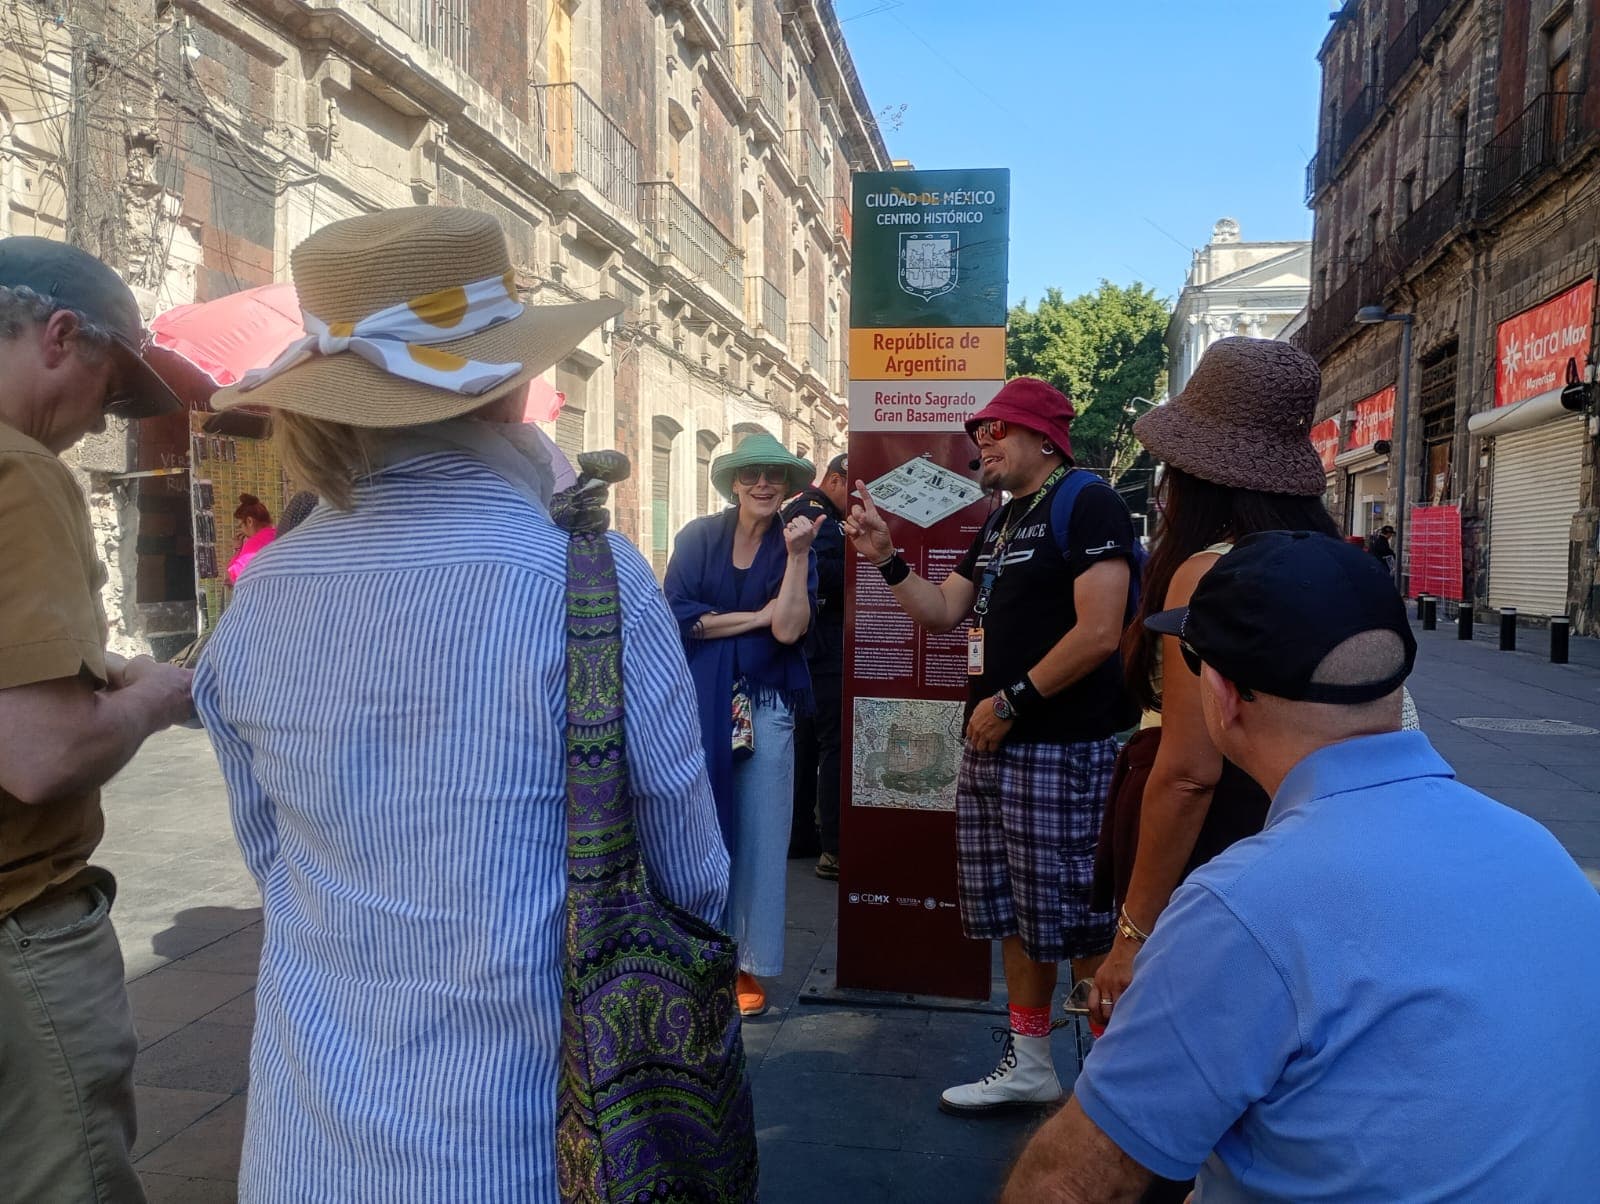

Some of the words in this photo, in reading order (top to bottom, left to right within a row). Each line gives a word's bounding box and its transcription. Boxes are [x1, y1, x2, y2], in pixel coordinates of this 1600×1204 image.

[865, 192, 917, 208] CIUDAD
[921, 191, 940, 207] DE
[943, 188, 996, 206] MÉXICO
[876, 212, 921, 226] CENTRO
[924, 209, 983, 225] HISTÓRICO
[873, 332, 955, 354] República
[960, 332, 980, 350] de
[1523, 330, 1560, 365] tiara
[1561, 324, 1588, 349] Max
[885, 355, 967, 377] Argentina
[874, 391, 922, 407] Recinto
[925, 391, 976, 409] Sagrado
[874, 408, 903, 423] Gran
[861, 893, 890, 904] CDMX
